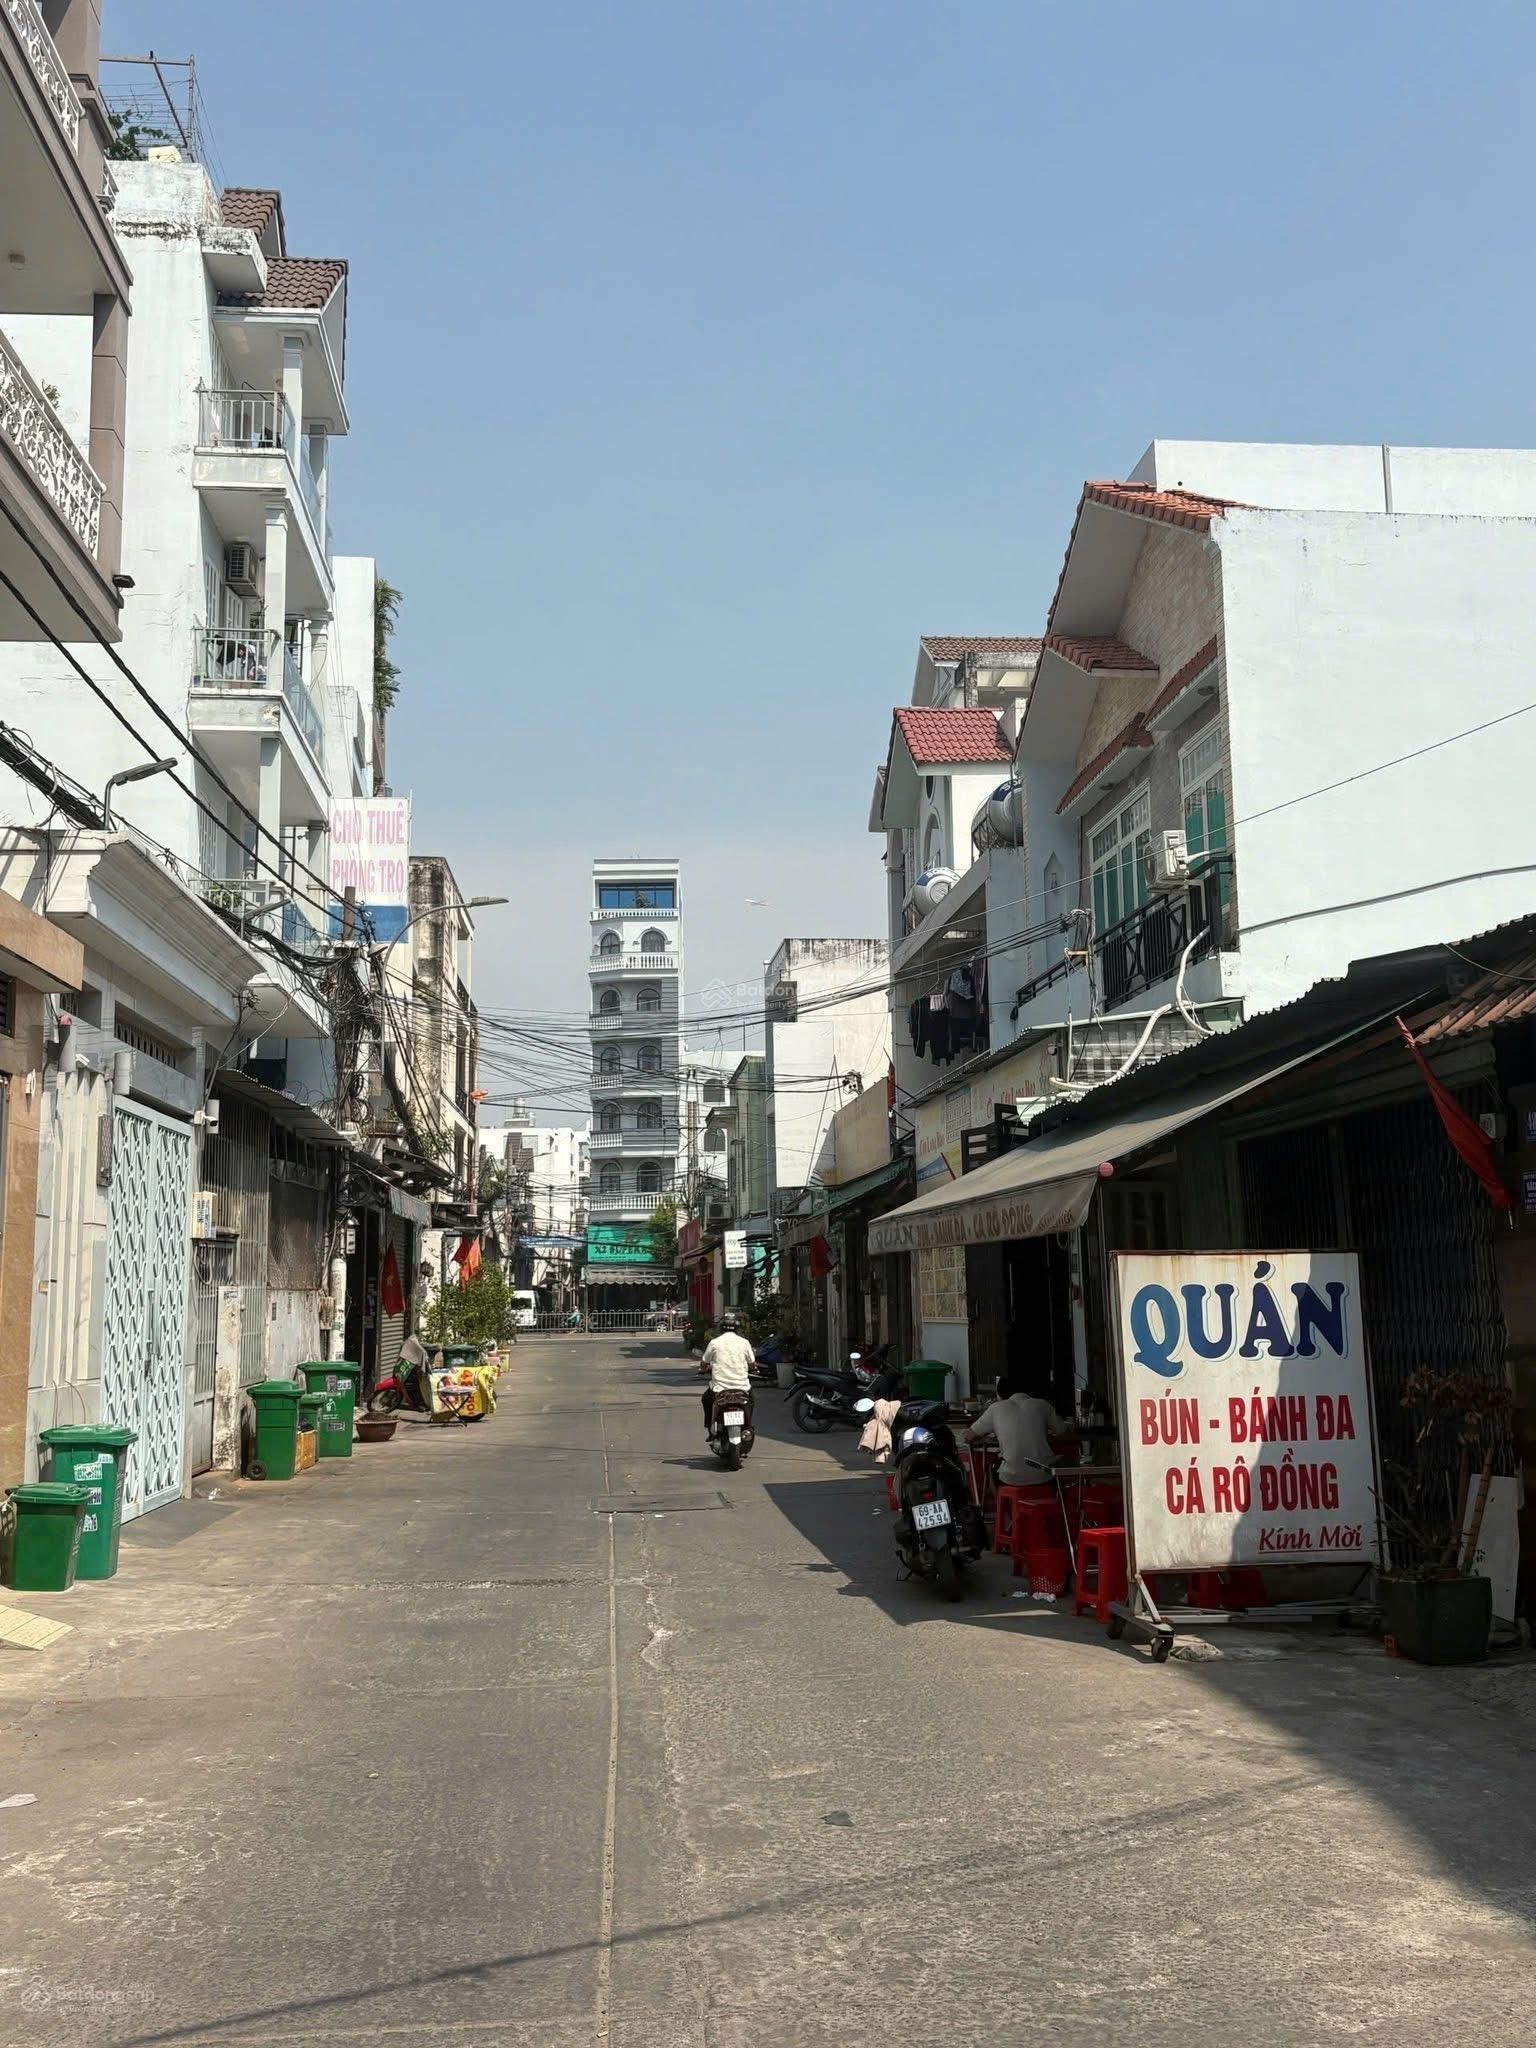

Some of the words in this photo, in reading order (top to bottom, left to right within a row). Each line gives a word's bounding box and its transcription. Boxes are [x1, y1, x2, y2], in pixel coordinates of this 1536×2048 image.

[332, 809, 362, 845] CHO
[367, 802, 405, 845] THUÊ
[1130, 1260, 1348, 1380] QUÁN
[1140, 1388, 1201, 1446] BÚN
[1228, 1386, 1308, 1443] BÁNH
[1315, 1394, 1356, 1441] ĐA
[1165, 1456, 1206, 1515] CÁ
[1212, 1455, 1251, 1514] RÔ
[1259, 1448, 1340, 1512] ĐỒNG
[1258, 1527, 1313, 1551] Kính
[1318, 1525, 1363, 1549] Mời
